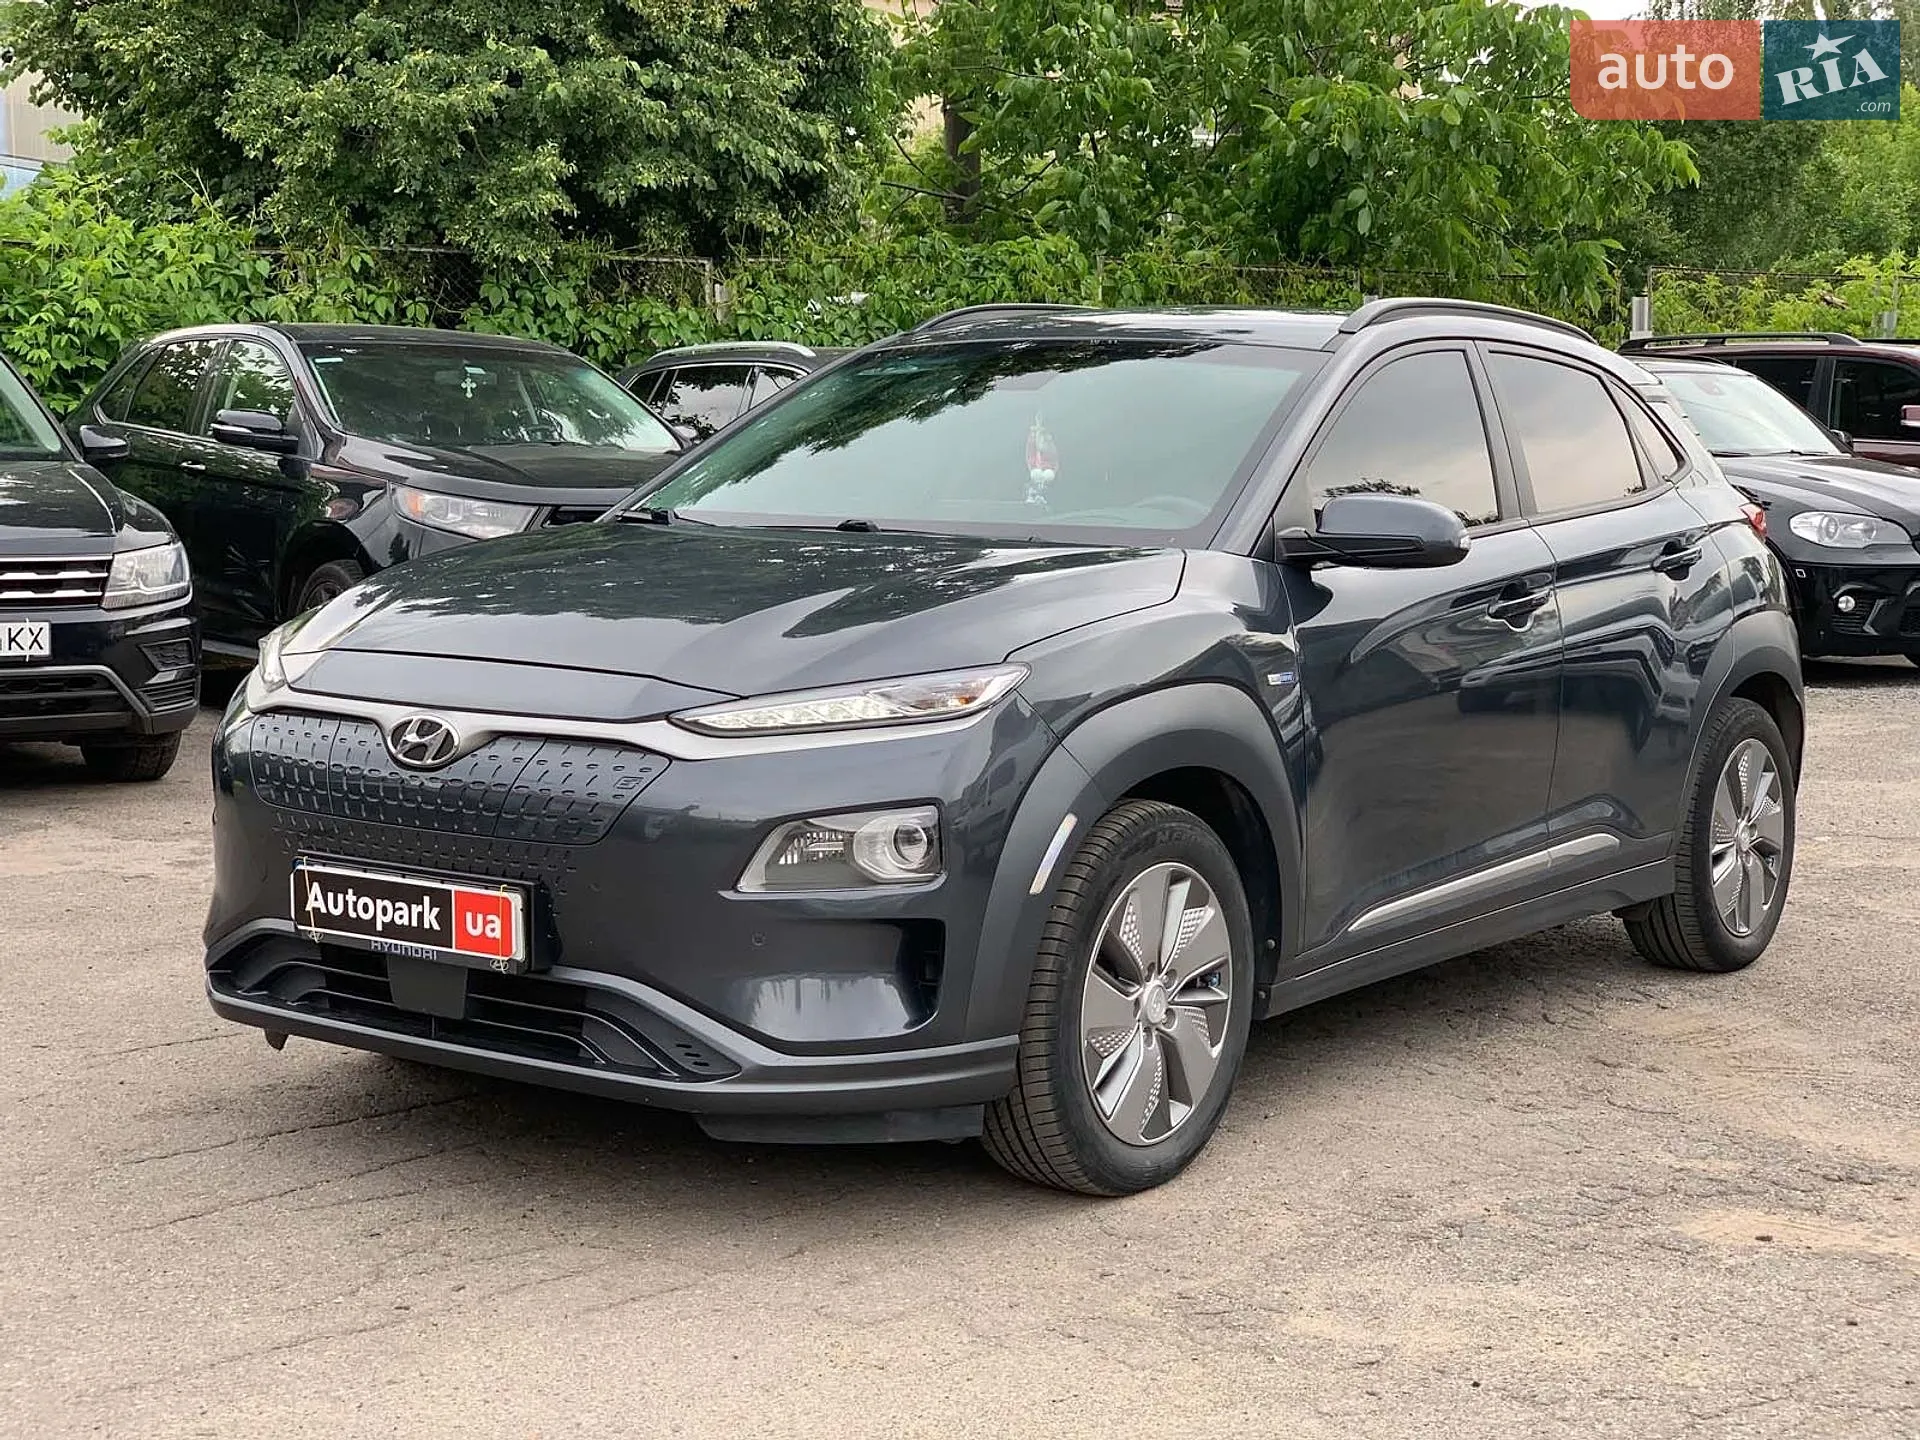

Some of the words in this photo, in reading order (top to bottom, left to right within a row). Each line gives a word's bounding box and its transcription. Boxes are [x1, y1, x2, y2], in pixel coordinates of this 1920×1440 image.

[8, 627, 43, 650] KX
[305, 882, 441, 931] Autopark
[464, 910, 502, 939] ua
[371, 940, 437, 960] HYUNDAI
